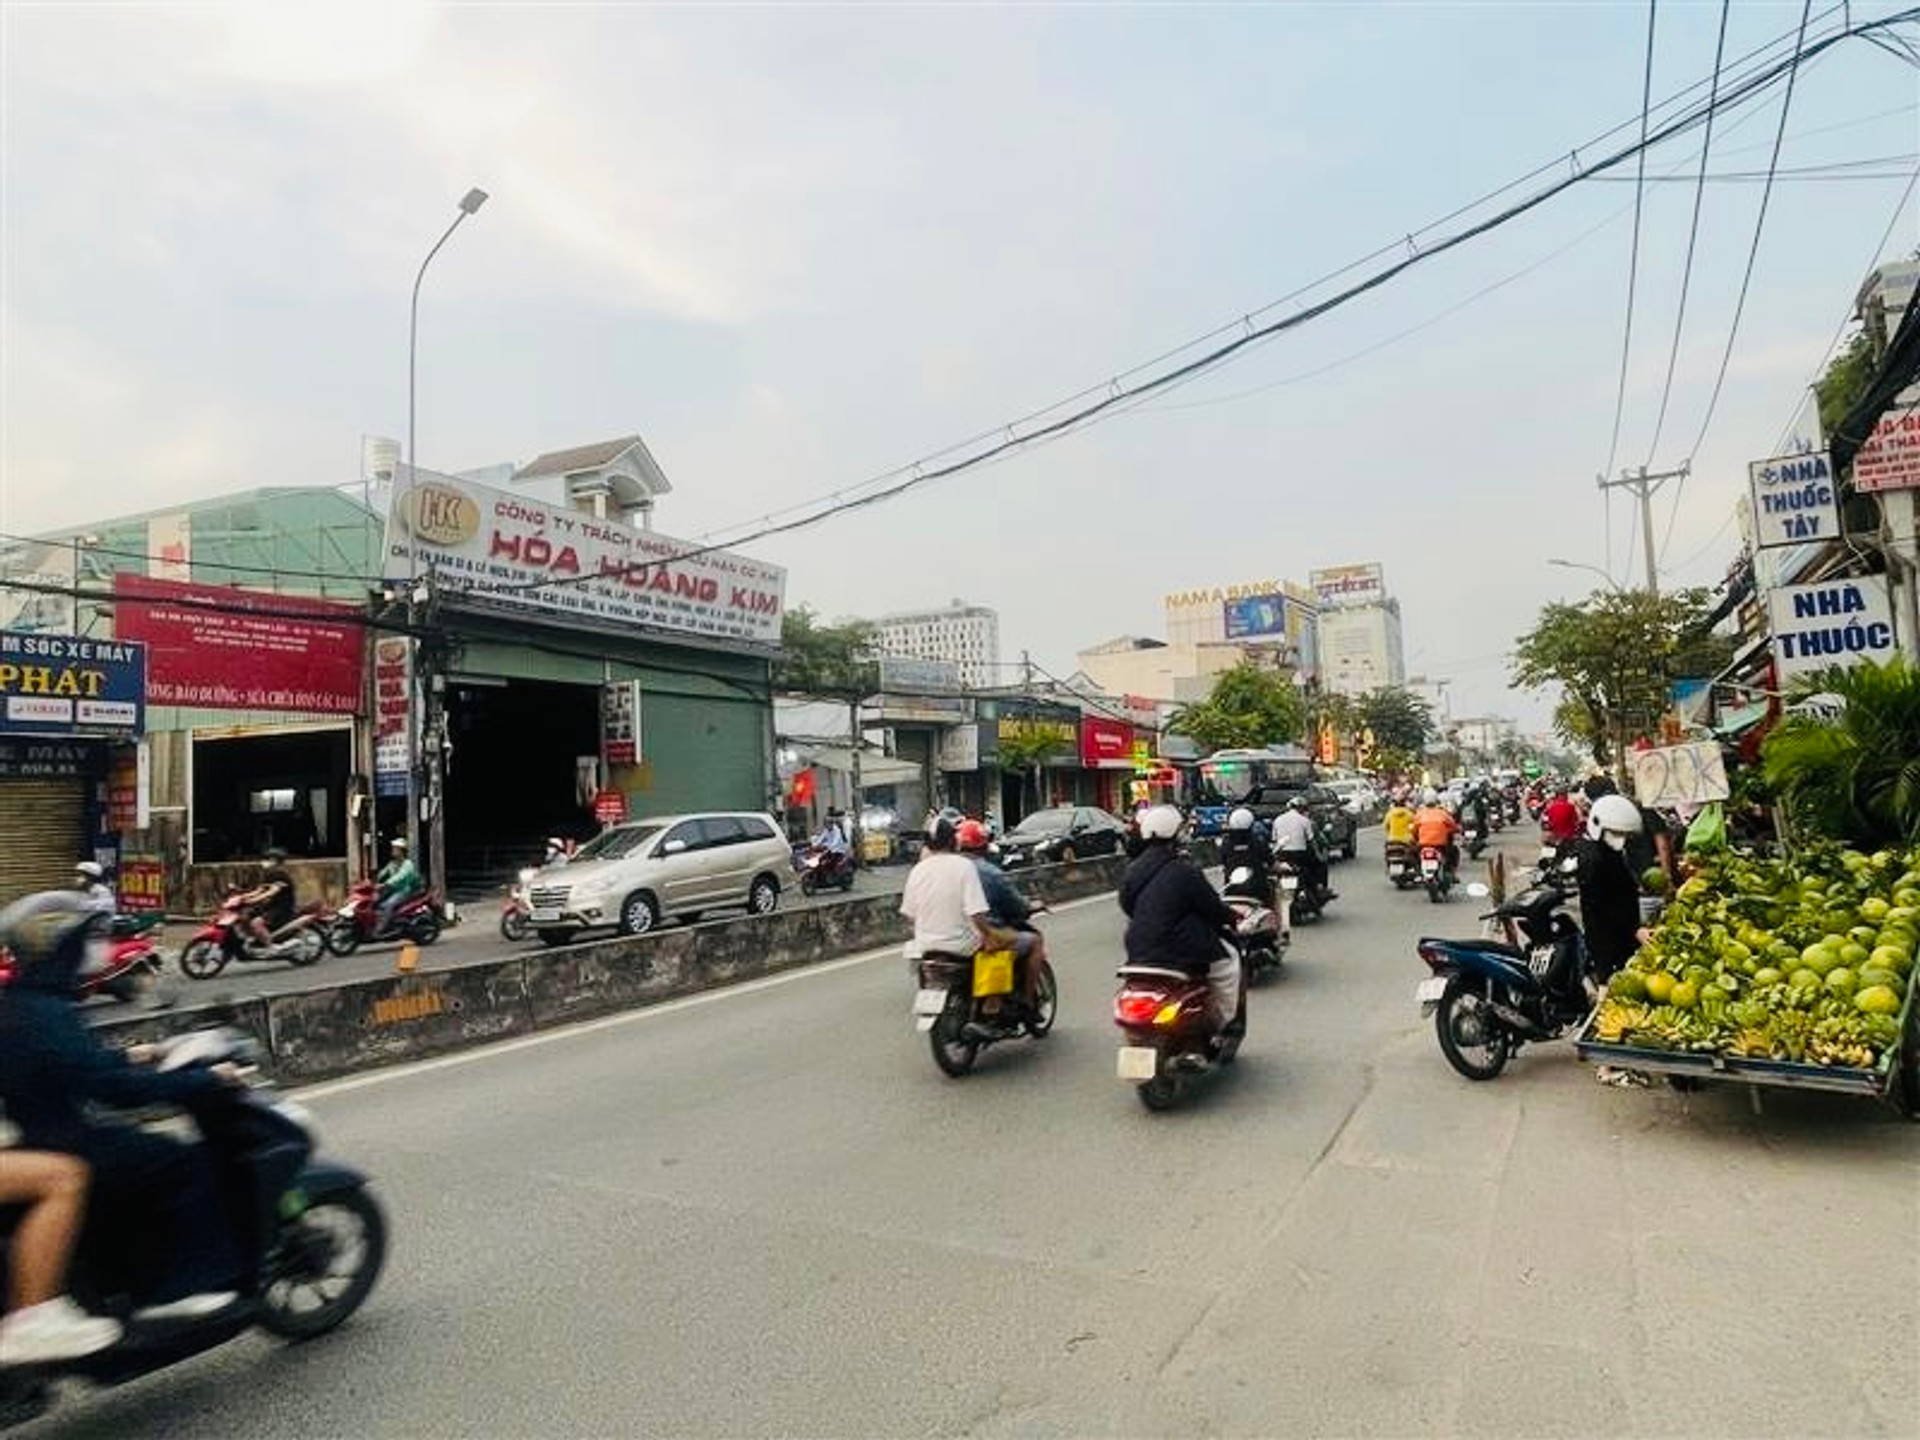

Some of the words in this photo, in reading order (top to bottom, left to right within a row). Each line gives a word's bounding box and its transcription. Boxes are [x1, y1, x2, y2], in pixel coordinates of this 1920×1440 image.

[1781, 456, 1828, 482] NHÀ
[1762, 481, 1831, 513] THUỐC
[495, 501, 546, 525] CÔNG
[553, 516, 575, 532] TY
[581, 522, 631, 544] TRÁCH
[1782, 513, 1820, 538] TÂY
[489, 529, 581, 575] HÓA
[600, 554, 719, 603] HOÀNG
[729, 585, 779, 616] KIM
[1793, 583, 1866, 618] NHÀ
[1776, 616, 1890, 659] THUỐC
